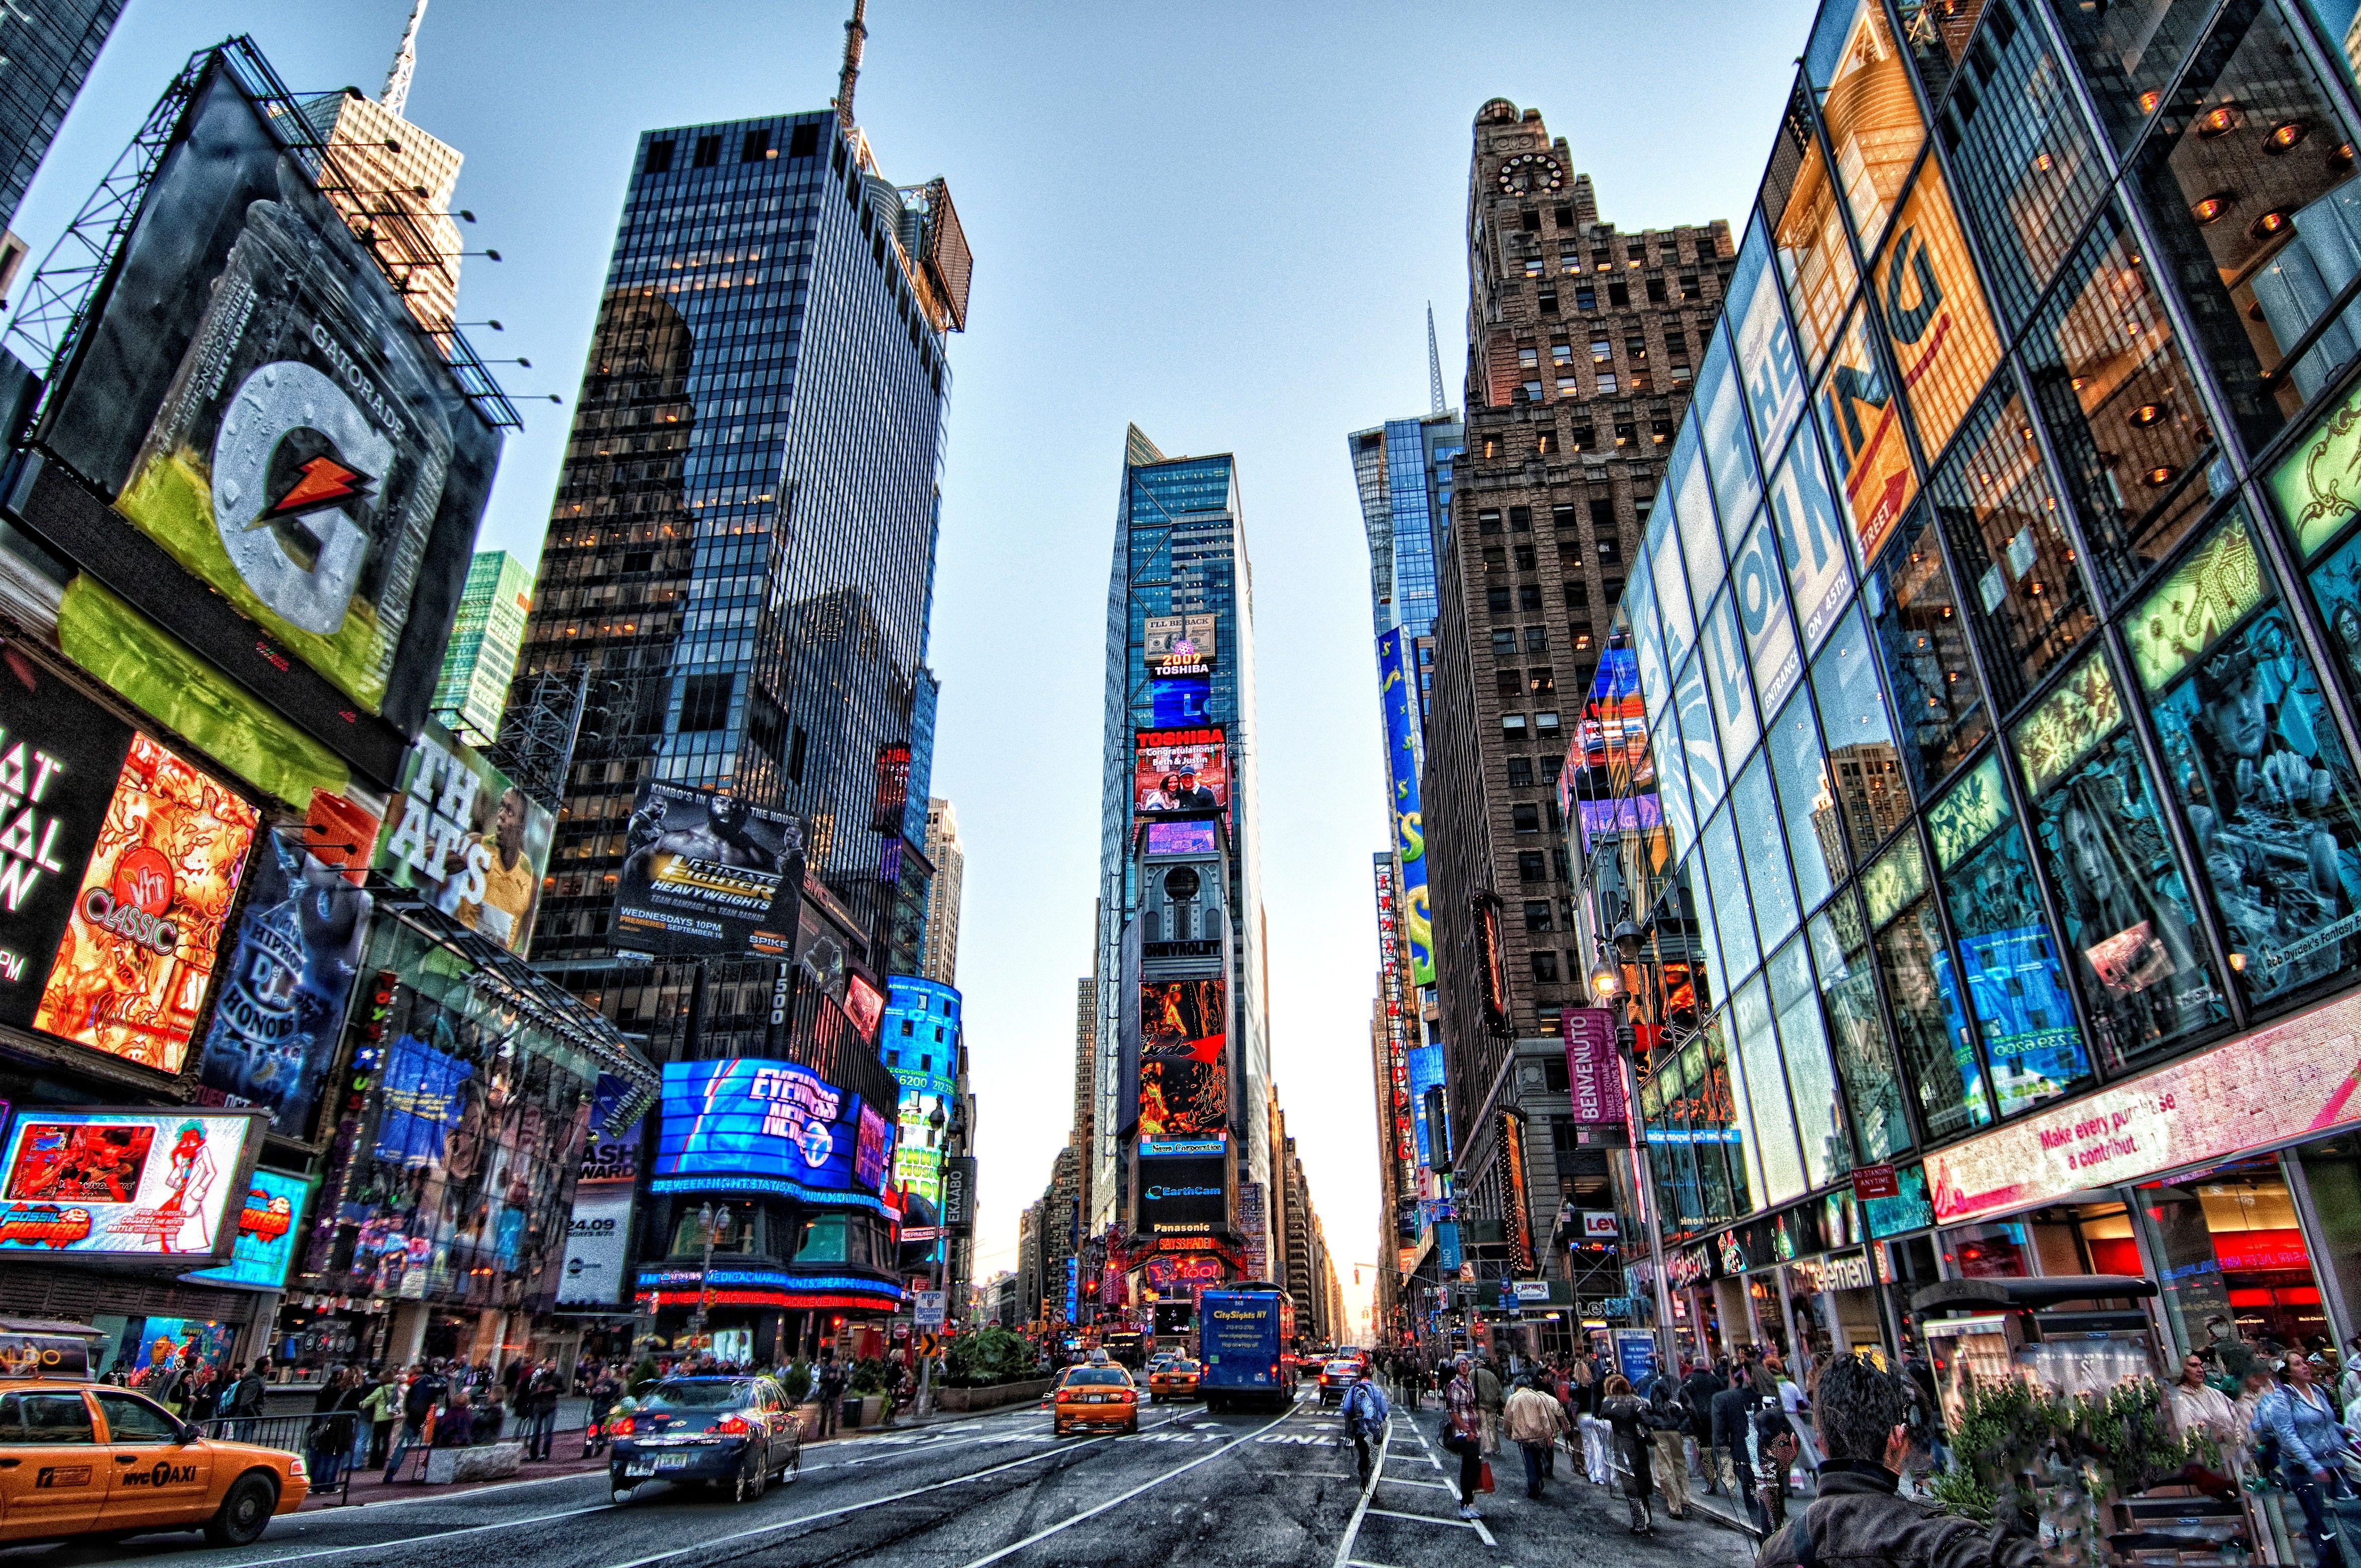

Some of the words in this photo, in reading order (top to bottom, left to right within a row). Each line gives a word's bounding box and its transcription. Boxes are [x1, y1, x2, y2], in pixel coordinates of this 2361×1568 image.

[310, 323, 406, 440] GATORADE
[1763, 646, 1801, 709] ENTRANCE
[1807, 610, 1823, 641] ON
[1825, 574, 1848, 614] 45TH
[1858, 501, 1892, 562] STREET
[1185, 618, 1209, 626] BACK
[1155, 664, 1209, 676] TOSHIBA
[1136, 729, 1225, 748] TOSHIBA
[1146, 746, 1215, 757] Congratulations
[1152, 757, 1173, 766] Beth
[1182, 756, 1208, 765] Justin
[650, 783, 693, 803] KIMBO'S
[695, 792, 707, 804] IN
[750, 807, 768, 820] THE
[769, 810, 801, 827] HOUSE
[669, 854, 783, 887] ULTIMATE
[656, 865, 776, 901] FIGHTER
[650, 879, 773, 911] HEAVYWEIGHTS
[650, 894, 671, 905] TEAM
[671, 898, 706, 912] RAMPAGE
[718, 907, 738, 918] TEAM
[737, 910, 765, 922] RASHAD
[80, 886, 178, 956] CLASSIC
[619, 916, 666, 929] PREMIERES
[666, 924, 713, 938] SEPTEMBER
[620, 906, 693, 927] WEDNESDAYS
[696, 920, 722, 932] 10PM
[749, 934, 789, 949] SPIKE
[2267, 951, 2282, 969] Rob
[2283, 937, 2319, 964] Dyrdek's
[2320, 919, 2354, 950] Fantasy
[770, 963, 787, 1025] 1500
[1604, 1014, 1615, 1040] WORLD
[1609, 1042, 1618, 1056] THE
[1570, 1015, 1601, 1120] BENVENUTO
[1610, 1059, 1619, 1068] OF
[899, 1074, 928, 1088] 6200
[1601, 1064, 1614, 1093] SQUARE
[1611, 1070, 1626, 1118] CROSSROADS
[1605, 1095, 1617, 1119] TIMES
[2039, 1127, 2073, 1150] Make
[2076, 1113, 2110, 1140] every
[1152, 1144, 1172, 1153] News
[1175, 1143, 1222, 1153] Corporation
[1863, 1168, 1893, 1177] STANDING
[2069, 1157, 2077, 1170] a
[1162, 1186, 1221, 1196] EarthCam
[1860, 1177, 1891, 1185] ANYTIME
[1, 1211, 60, 1226] FOSSIL
[1154, 1223, 1211, 1232] Panasonic
[1443, 1248, 1453, 1269] UNO
[706, 1271, 753, 1284] MEDICAL
[921, 1292, 941, 1300] NYPD
[1213, 1310, 1256, 1321] CitySights
[122, 1472, 151, 1487] NYC
[151, 1460, 196, 1488] TAXI
